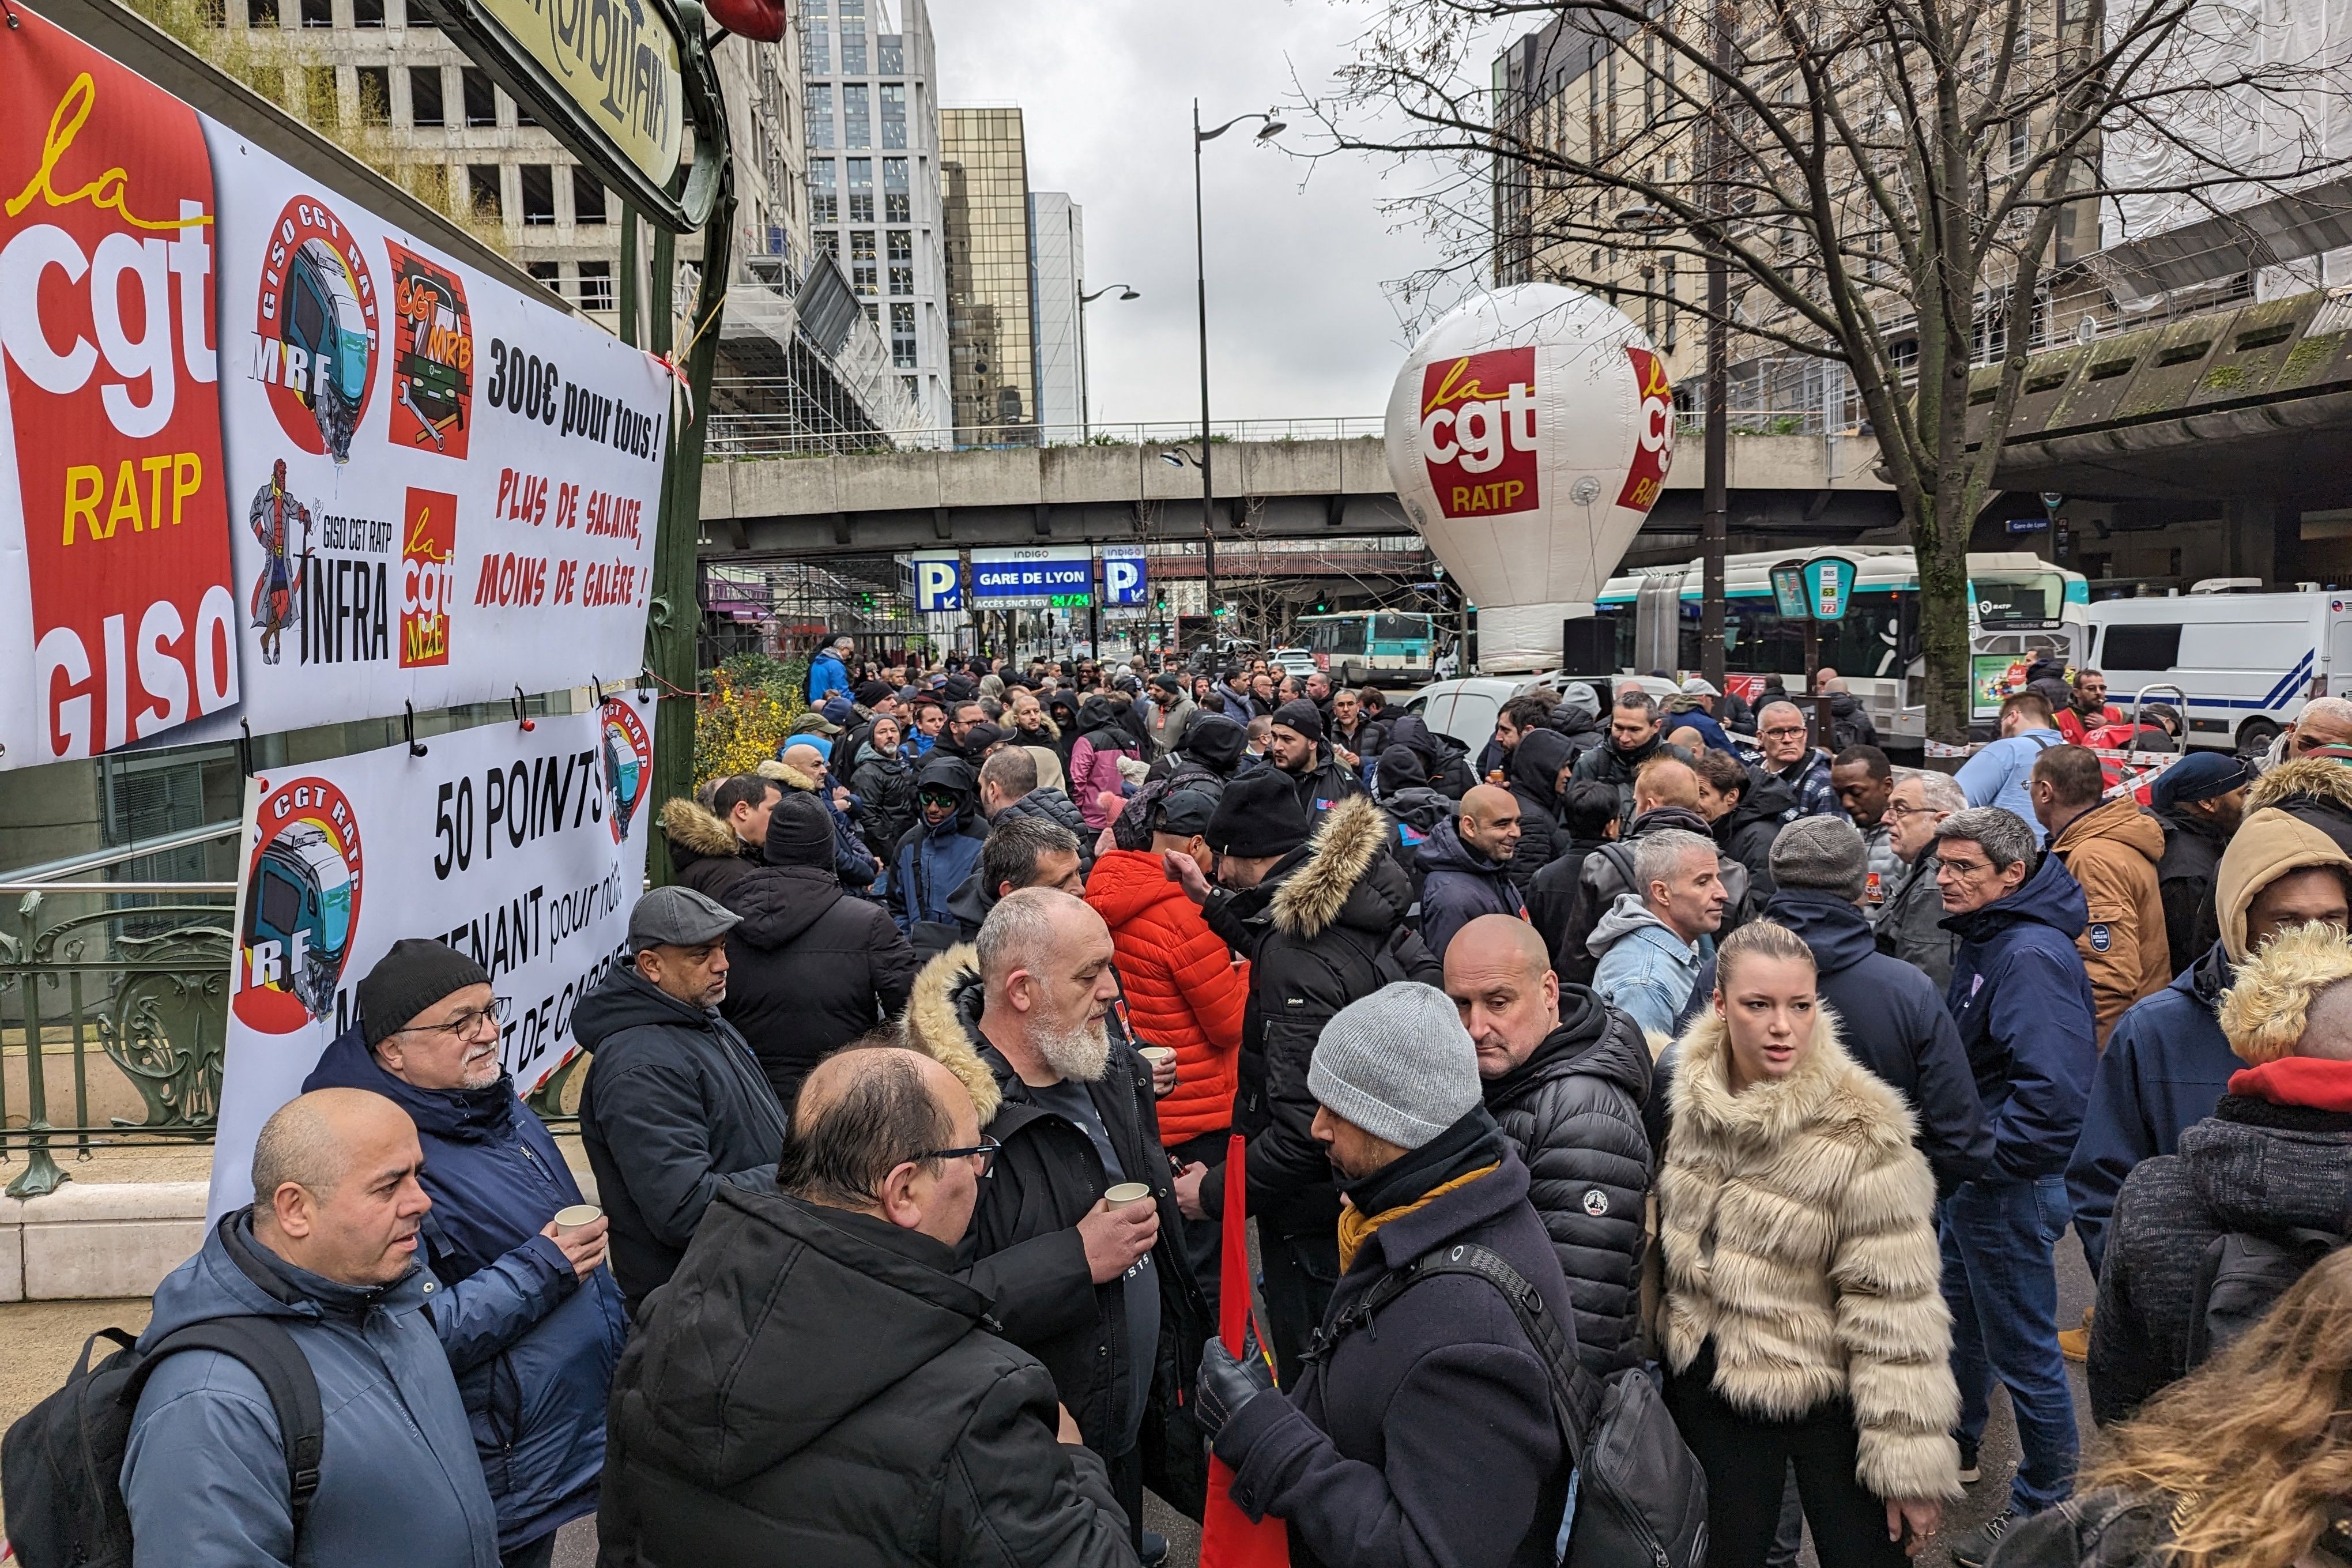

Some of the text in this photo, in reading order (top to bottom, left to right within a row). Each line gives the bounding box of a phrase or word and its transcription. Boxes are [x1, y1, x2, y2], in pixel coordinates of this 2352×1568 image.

[5, 73, 214, 229] la
[299, 203, 340, 240] CGT
[348, 243, 377, 352] RATP
[397, 277, 438, 325] CGT
[0, 199, 218, 438] cgt
[427, 325, 473, 369] MRB
[247, 331, 332, 398] MRF
[488, 338, 558, 426] 300€
[560, 380, 611, 444] pour
[1423, 357, 1535, 414] la
[1420, 382, 1537, 473] cgt
[62, 452, 202, 546] RATP
[496, 468, 642, 550] PLUS DE SALAIRE,
[1452, 480, 1525, 512] RATP
[323, 515, 392, 554] GISO CGT RATP
[404, 507, 454, 560] la
[1014, 550, 1049, 559] INDIGO
[1107, 548, 1141, 556] INDIGO
[401, 549, 453, 633] cgt
[474, 552, 546, 609] MOINS
[553, 560, 578, 606] DE
[583, 556, 635, 609] GALÈRE
[975, 597, 1048, 609] ACCÈS SNCF TGV
[979, 571, 1085, 585] GARE DE LYON
[1822, 587, 1836, 597] 63
[1822, 605, 1835, 613] 72
[294, 551, 389, 668] INFRA
[406, 614, 444, 663] M2E
[35, 585, 239, 756] GISO
[624, 713, 648, 769] RATP
[273, 785, 359, 892] CGT RATP
[434, 744, 602, 880] 50 POINTS
[550, 883, 598, 963] pour
[517, 994, 555, 1074] DE
